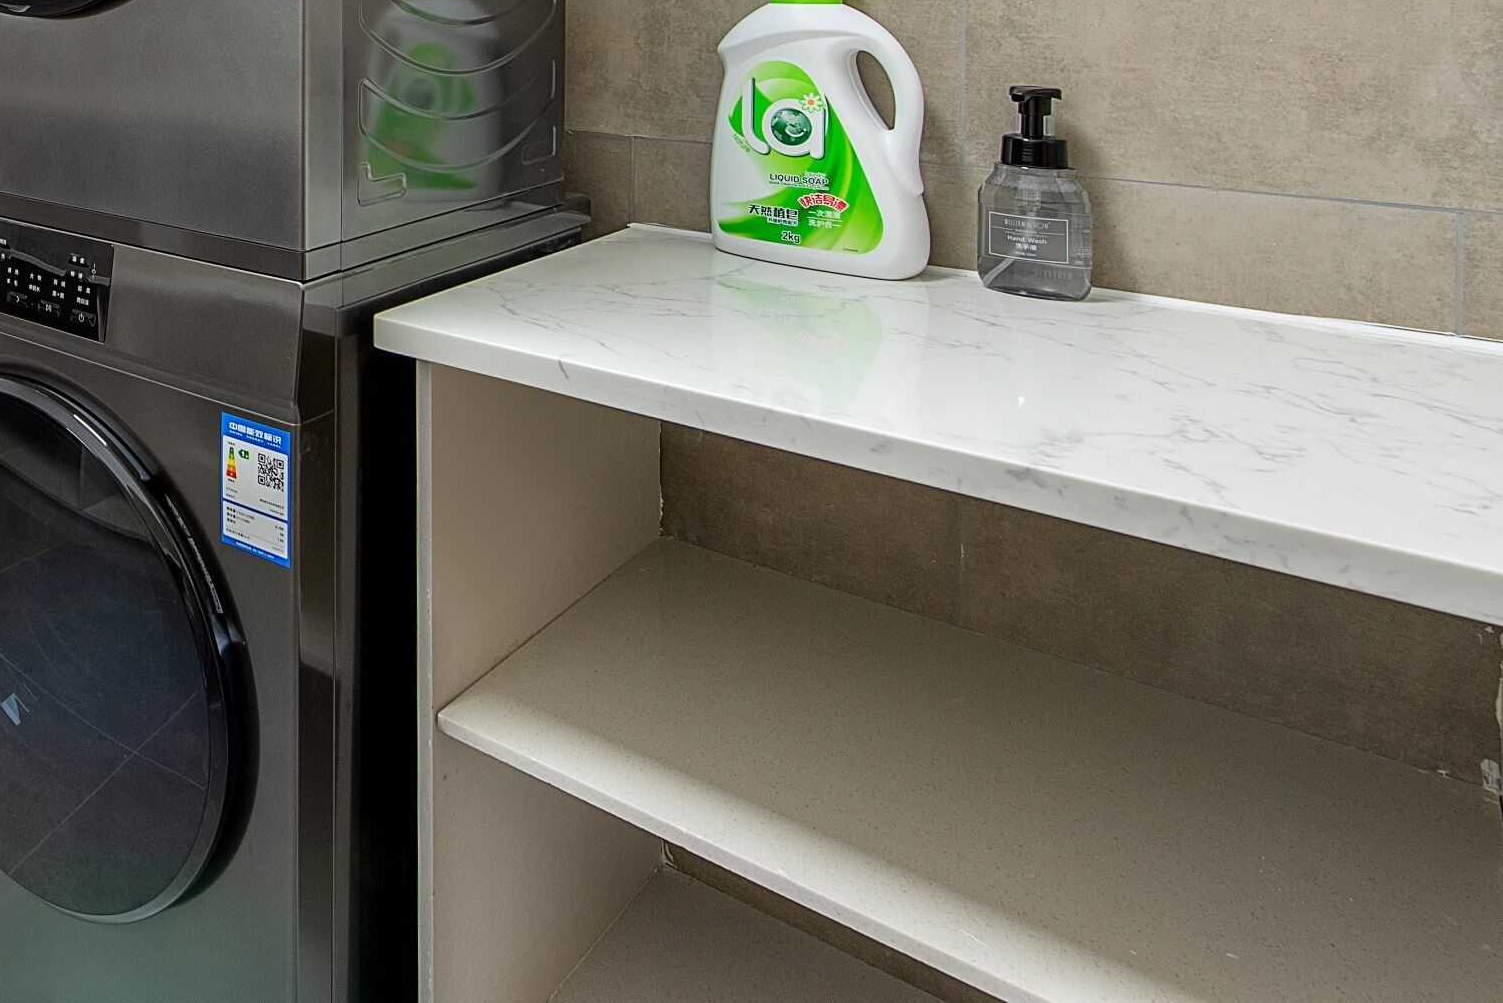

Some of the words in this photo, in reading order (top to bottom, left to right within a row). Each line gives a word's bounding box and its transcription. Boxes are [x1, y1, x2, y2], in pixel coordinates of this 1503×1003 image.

[732, 133, 751, 153] Nature
[769, 173, 800, 183] LIQUID
[802, 176, 829, 185] SOAP
[799, 193, 849, 212] 快洁易漂
[748, 204, 798, 219] 天然植皂
[782, 231, 801, 244] 2kg
[1007, 234, 1025, 242] Hand
[1028, 237, 1047, 245] Wash
[229, 421, 282, 445] 中国能效标识
